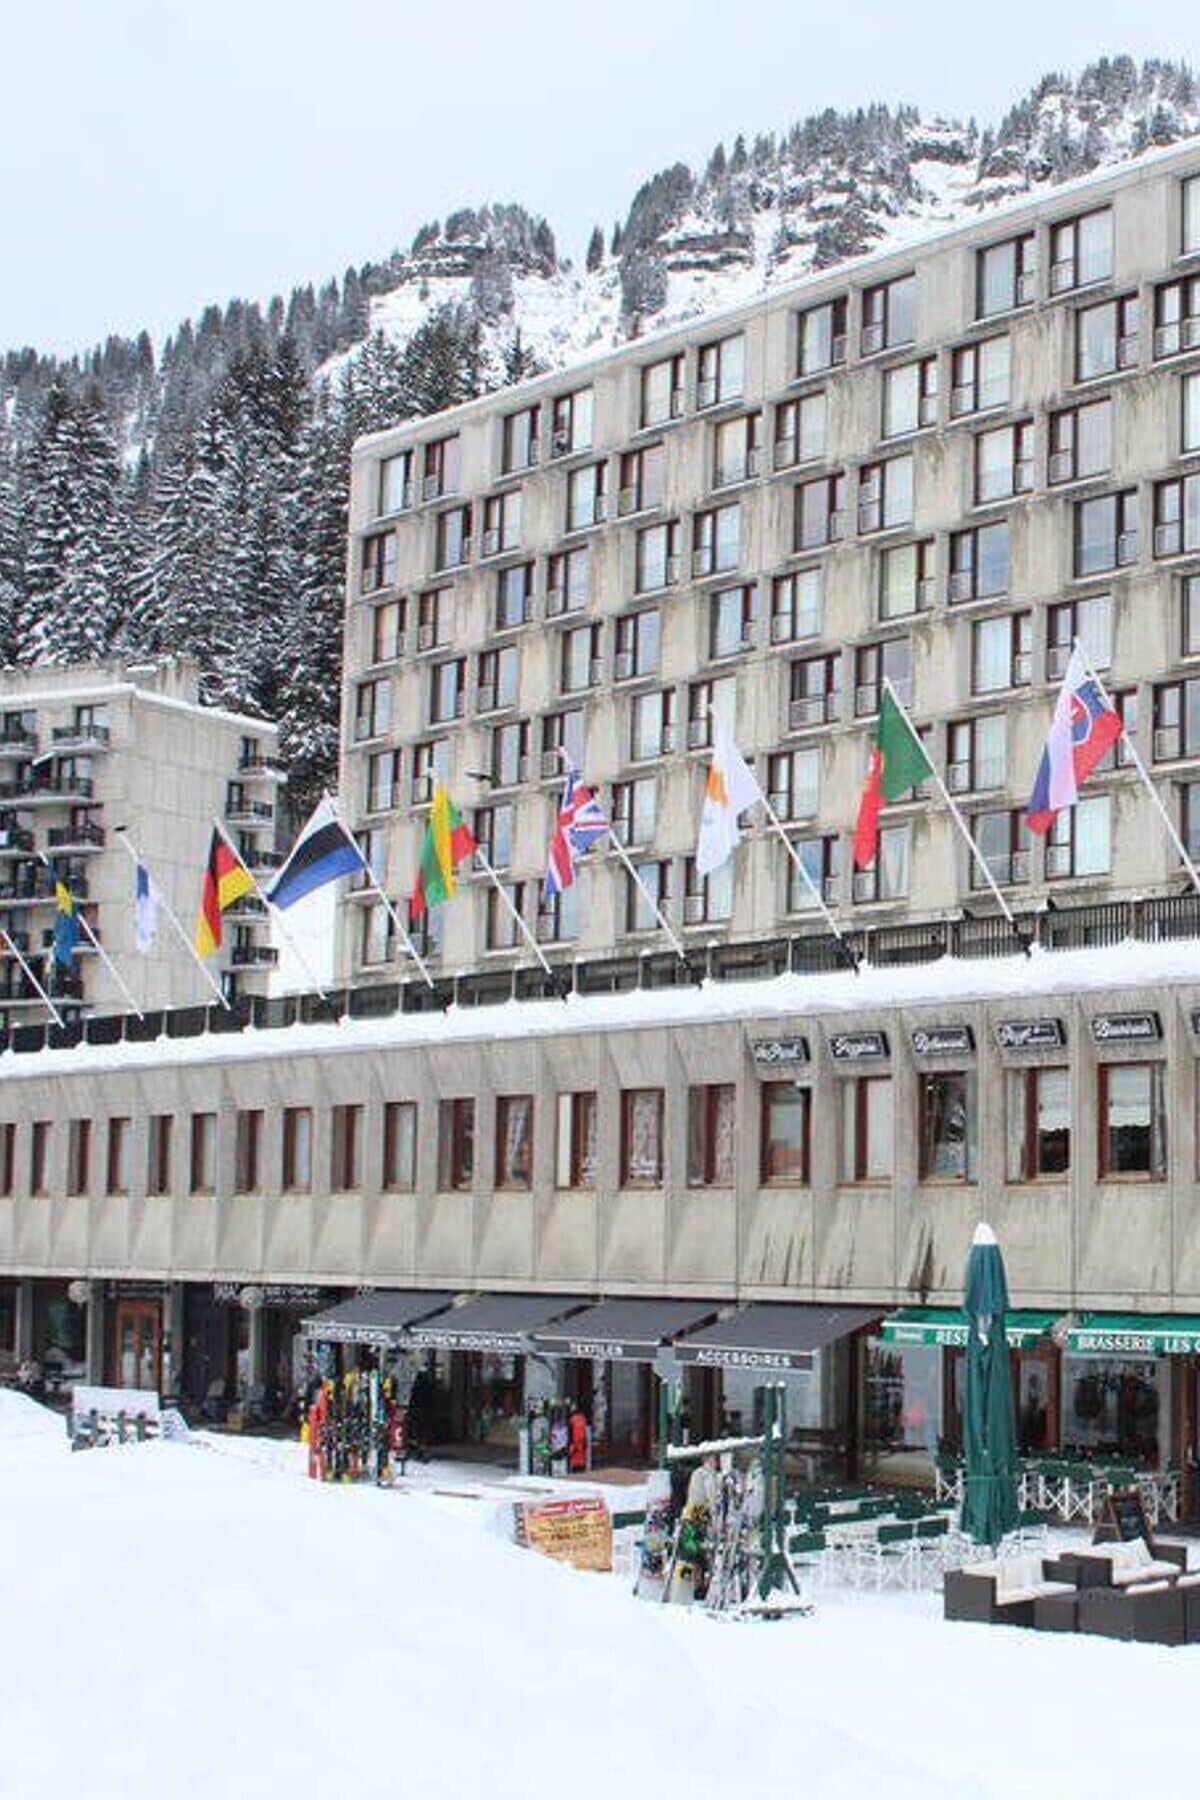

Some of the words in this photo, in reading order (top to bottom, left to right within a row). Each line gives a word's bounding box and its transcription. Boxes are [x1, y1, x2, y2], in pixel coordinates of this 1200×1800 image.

[570, 1341, 623, 1355] TEXTILES
[1078, 1334, 1155, 1351] BRASSERIE
[1164, 1336, 1190, 1353] LES
[697, 1351, 791, 1367] ACCESSOIRES
